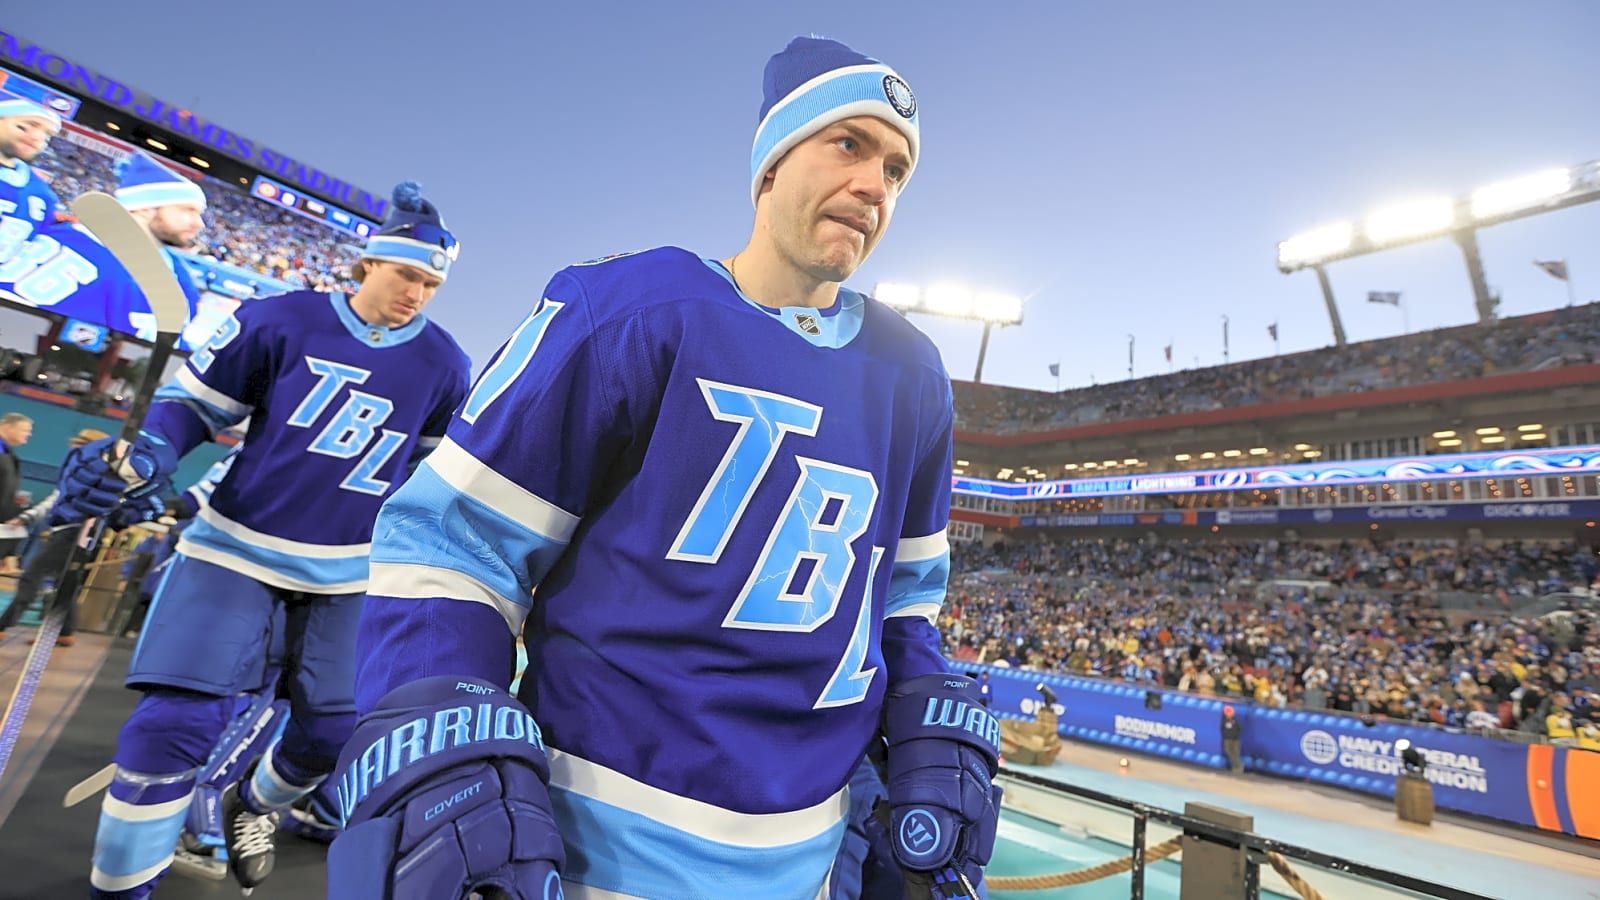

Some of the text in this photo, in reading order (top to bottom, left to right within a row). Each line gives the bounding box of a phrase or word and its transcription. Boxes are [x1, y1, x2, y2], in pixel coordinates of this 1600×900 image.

[134, 99, 253, 160] JAMES
[257, 147, 390, 218] STADIUM
[286, 355, 408, 496] TBL
[1131, 476, 1196, 490] LIGHTNING
[664, 377, 886, 710] TBL
[455, 681, 495, 696] POINT
[944, 680, 970, 689] POINT
[922, 697, 999, 749] WAR
[1338, 734, 1392, 756] NAVY
[336, 703, 547, 831] WARRIOR
[424, 780, 484, 821] COVERT
